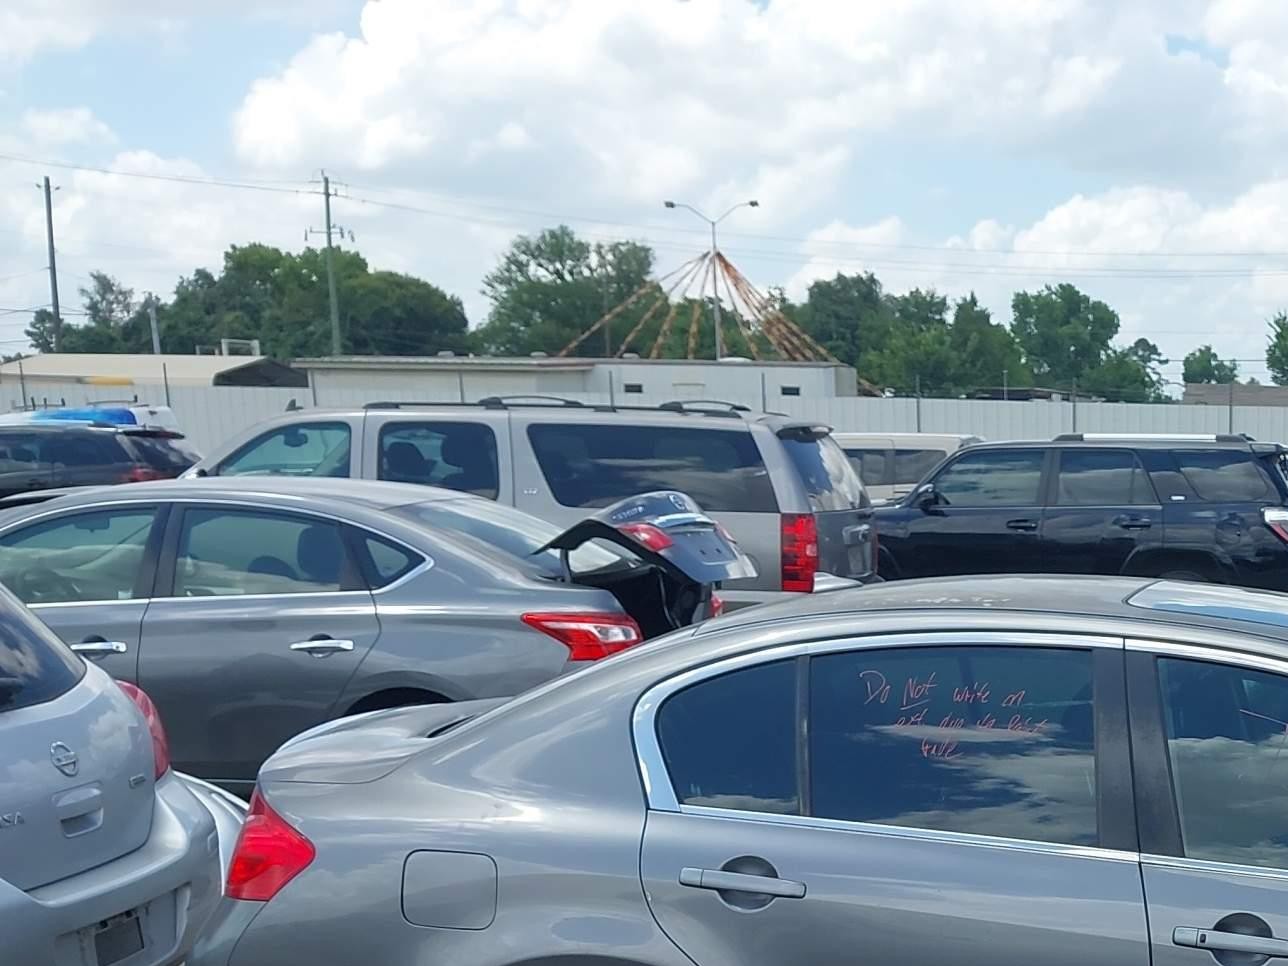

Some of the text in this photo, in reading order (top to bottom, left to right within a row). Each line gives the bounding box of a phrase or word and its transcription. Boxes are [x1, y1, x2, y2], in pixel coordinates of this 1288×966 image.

[859, 670, 892, 705] Do
[901, 671, 938, 710] Not
[952, 681, 992, 705] write
